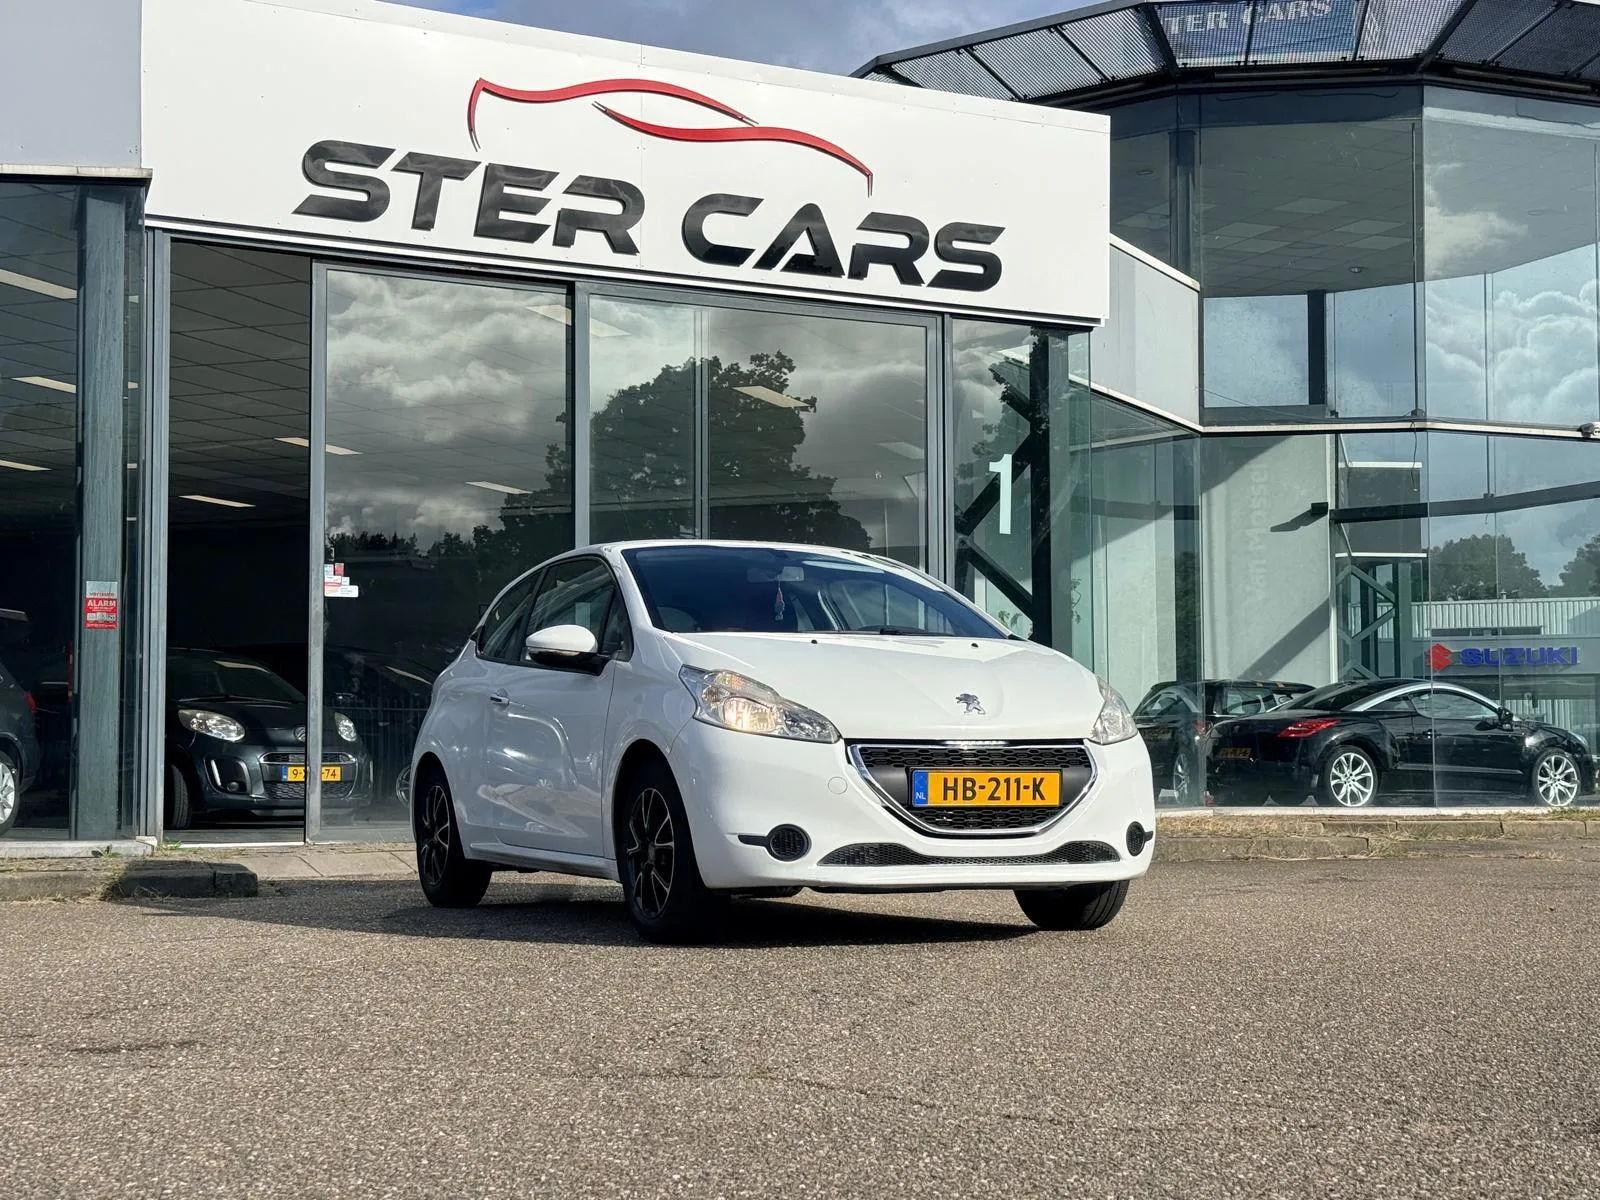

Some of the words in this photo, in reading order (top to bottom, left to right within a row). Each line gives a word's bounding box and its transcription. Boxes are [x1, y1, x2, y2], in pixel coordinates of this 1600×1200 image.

[1242, 0, 1333, 26] CARS
[291, 139, 646, 256] STER
[681, 192, 1006, 292] CARS
[988, 453, 1013, 535] 1
[87, 599, 117, 607] ALARM
[1460, 647, 1578, 667] SUZUKI
[915, 791, 927, 801] NL
[943, 777, 1046, 801] HB-211-K
